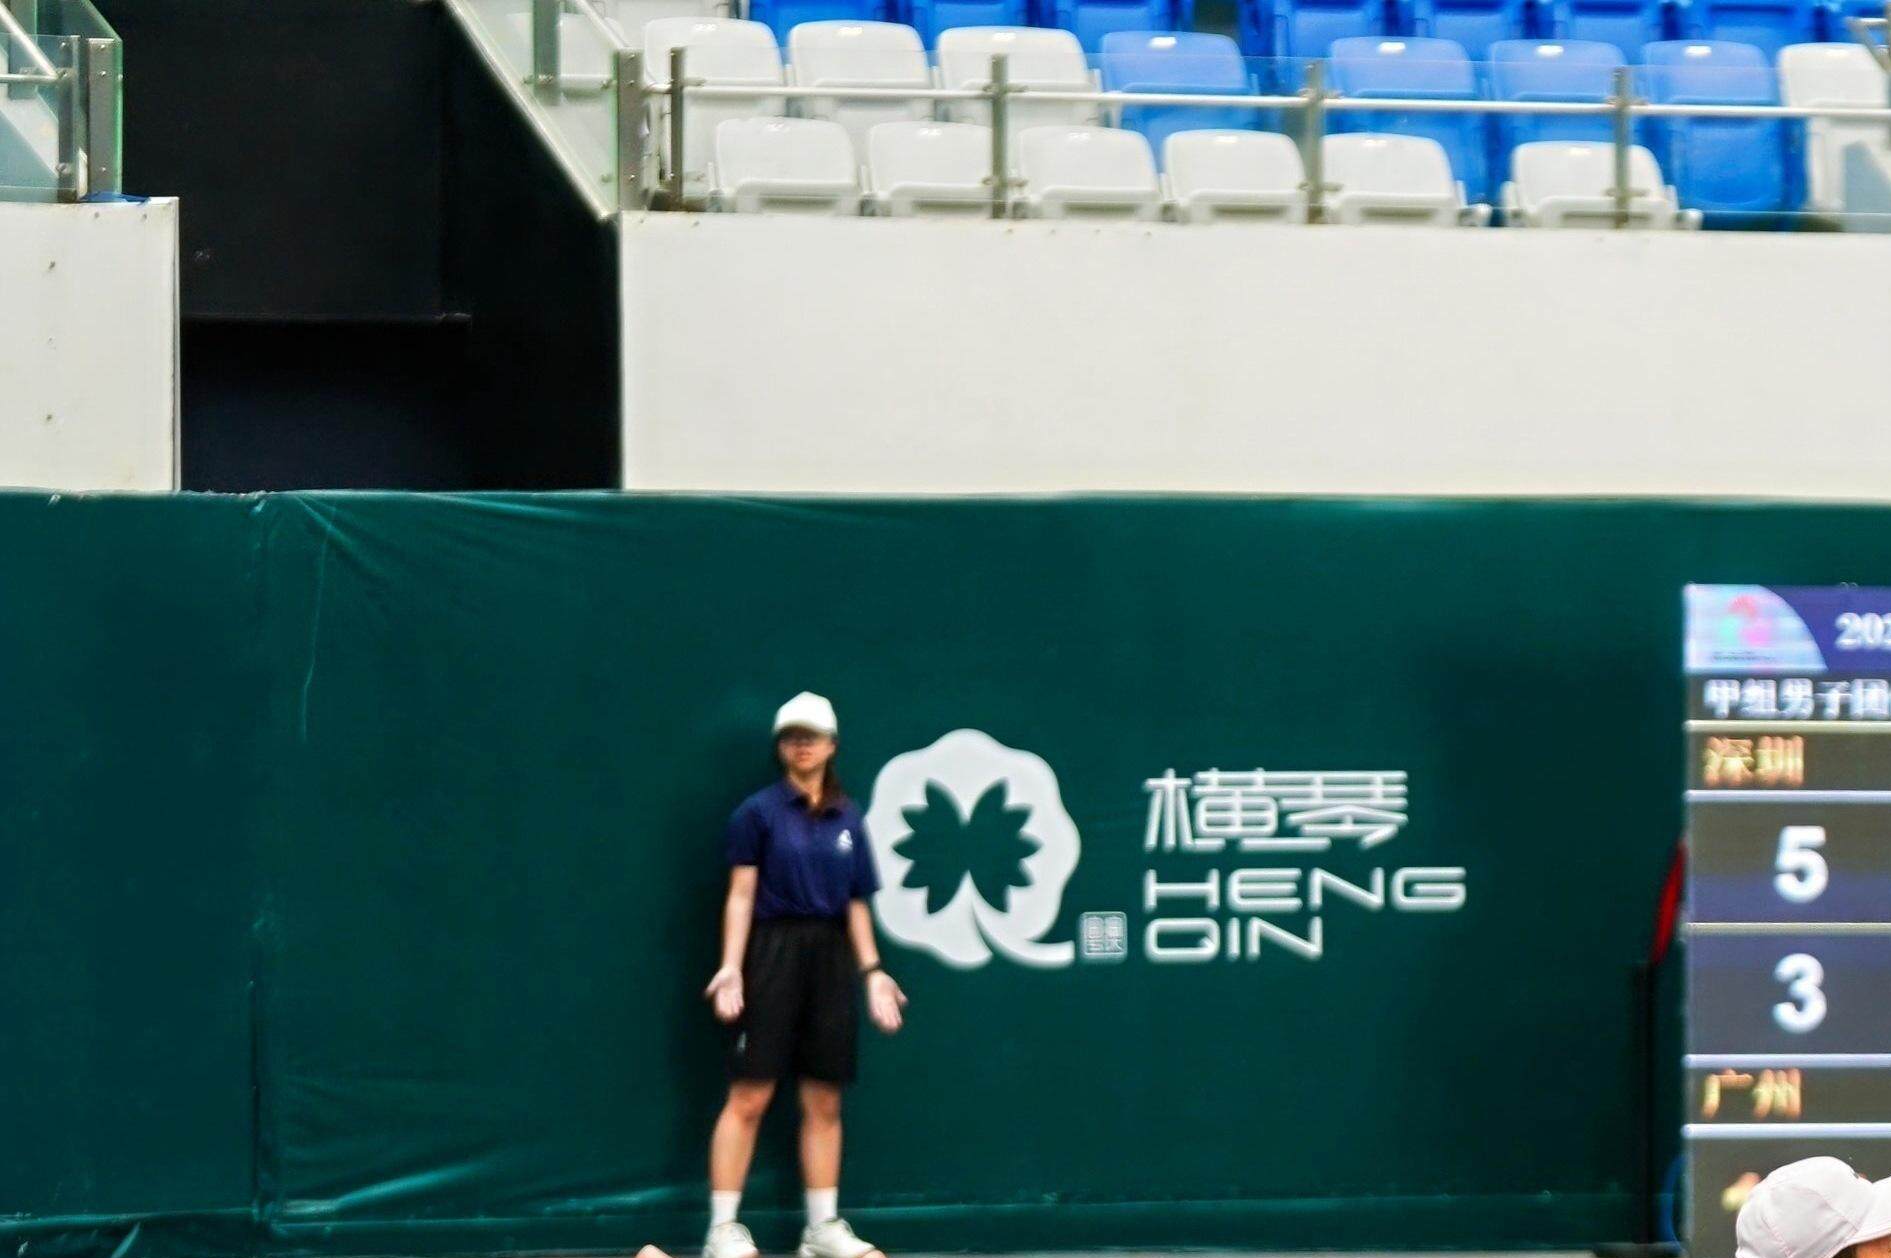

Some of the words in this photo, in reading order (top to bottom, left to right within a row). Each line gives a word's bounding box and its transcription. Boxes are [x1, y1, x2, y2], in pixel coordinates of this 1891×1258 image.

[1703, 735, 1805, 788] 深圳
[1143, 767, 1408, 852] 横琴
[1144, 866, 1467, 914] HENG
[1773, 825, 1829, 902] 5
[1145, 915, 1323, 963] QIN
[1772, 952, 1828, 1034] 3
[1702, 1068, 1802, 1120] 广州
